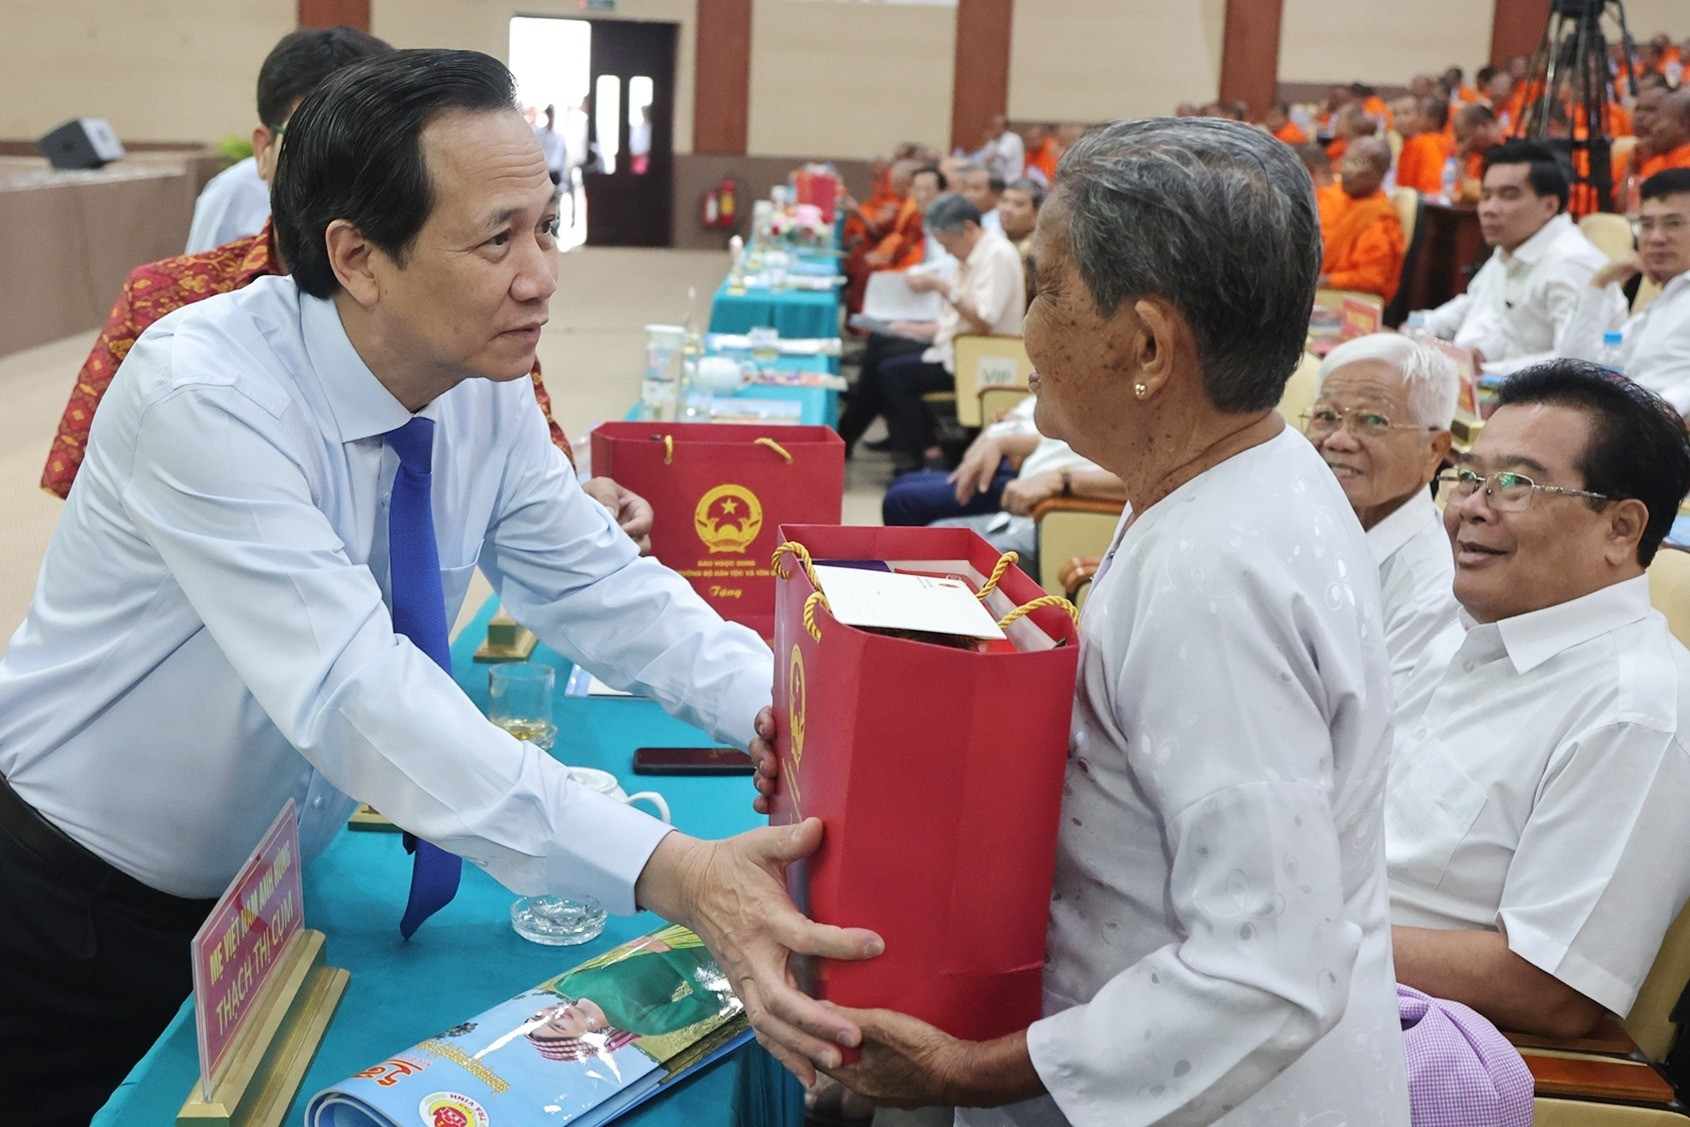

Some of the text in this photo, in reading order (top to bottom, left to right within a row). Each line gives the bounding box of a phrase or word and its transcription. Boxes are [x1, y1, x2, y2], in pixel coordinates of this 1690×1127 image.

[983, 368, 1012, 383] VIP
[210, 840, 291, 985] MẸ VIỆT NAM ANH HÙNG
[216, 890, 293, 1036] THẠCH THỊ CỤM
